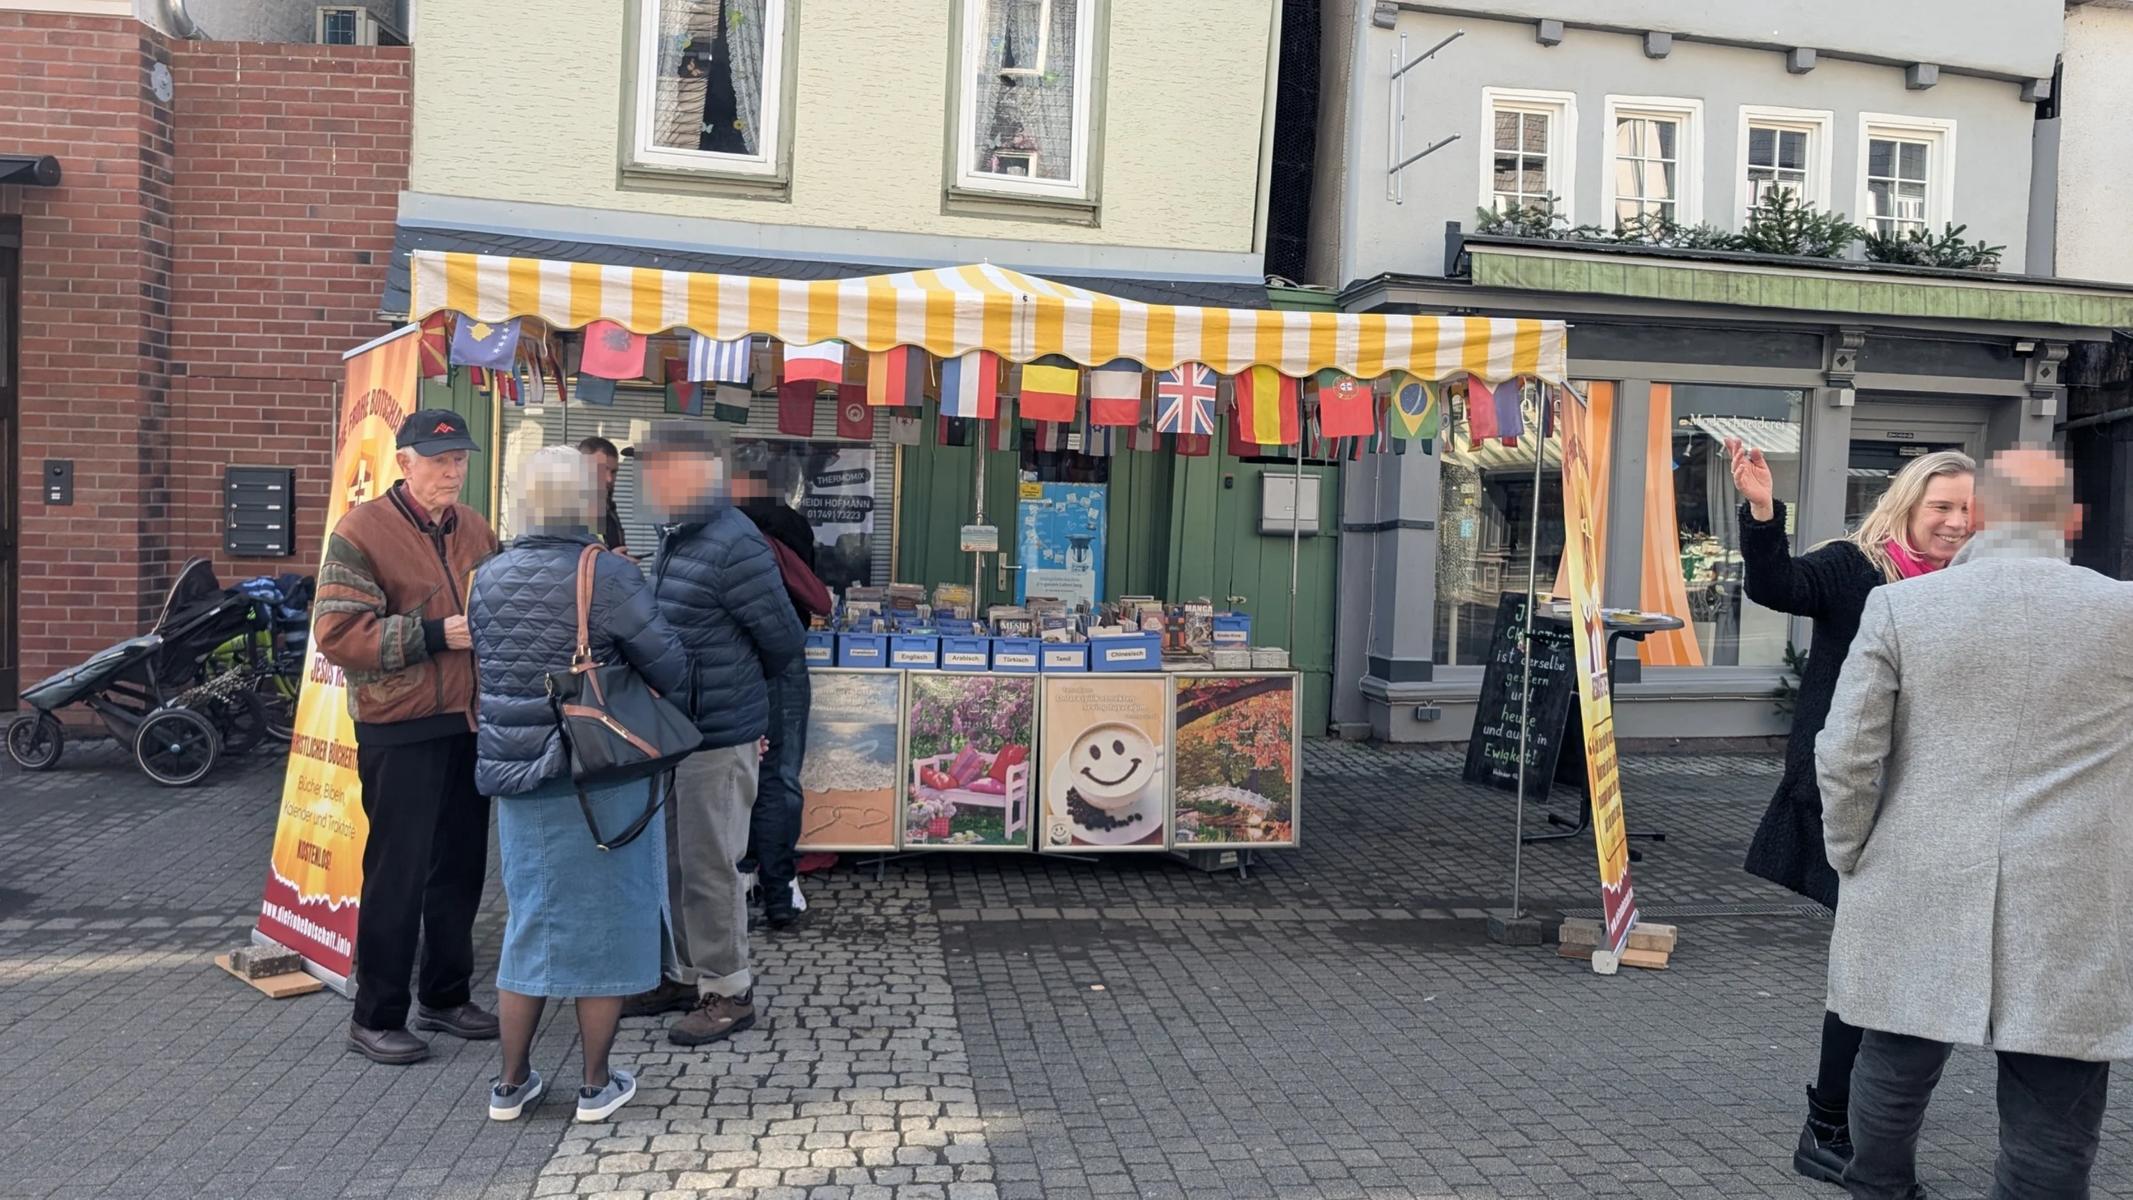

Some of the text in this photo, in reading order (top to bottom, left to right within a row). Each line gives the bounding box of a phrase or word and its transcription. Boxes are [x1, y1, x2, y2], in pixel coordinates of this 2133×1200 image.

[1689, 413, 1786, 430] Modeschneiderei
[816, 472, 865, 486] THERMOMIX
[825, 498, 870, 509] HOFMANN
[1184, 604, 1213, 617] MANGA
[901, 653, 928, 661] Englisch
[1056, 655, 1072, 663] Tamil
[1110, 650, 1144, 658] Chinesisch
[1496, 648, 1516, 664] ist
[310, 656, 334, 686] JESUS
[1483, 722, 1505, 737] und
[1536, 733, 1549, 746] in
[328, 738, 358, 771] BÜCHERT
[297, 775, 346, 806] Bücher, Bibeln,
[284, 799, 357, 840] Kalender und Traktate
[296, 839, 333, 871] KOSTENLOS!
